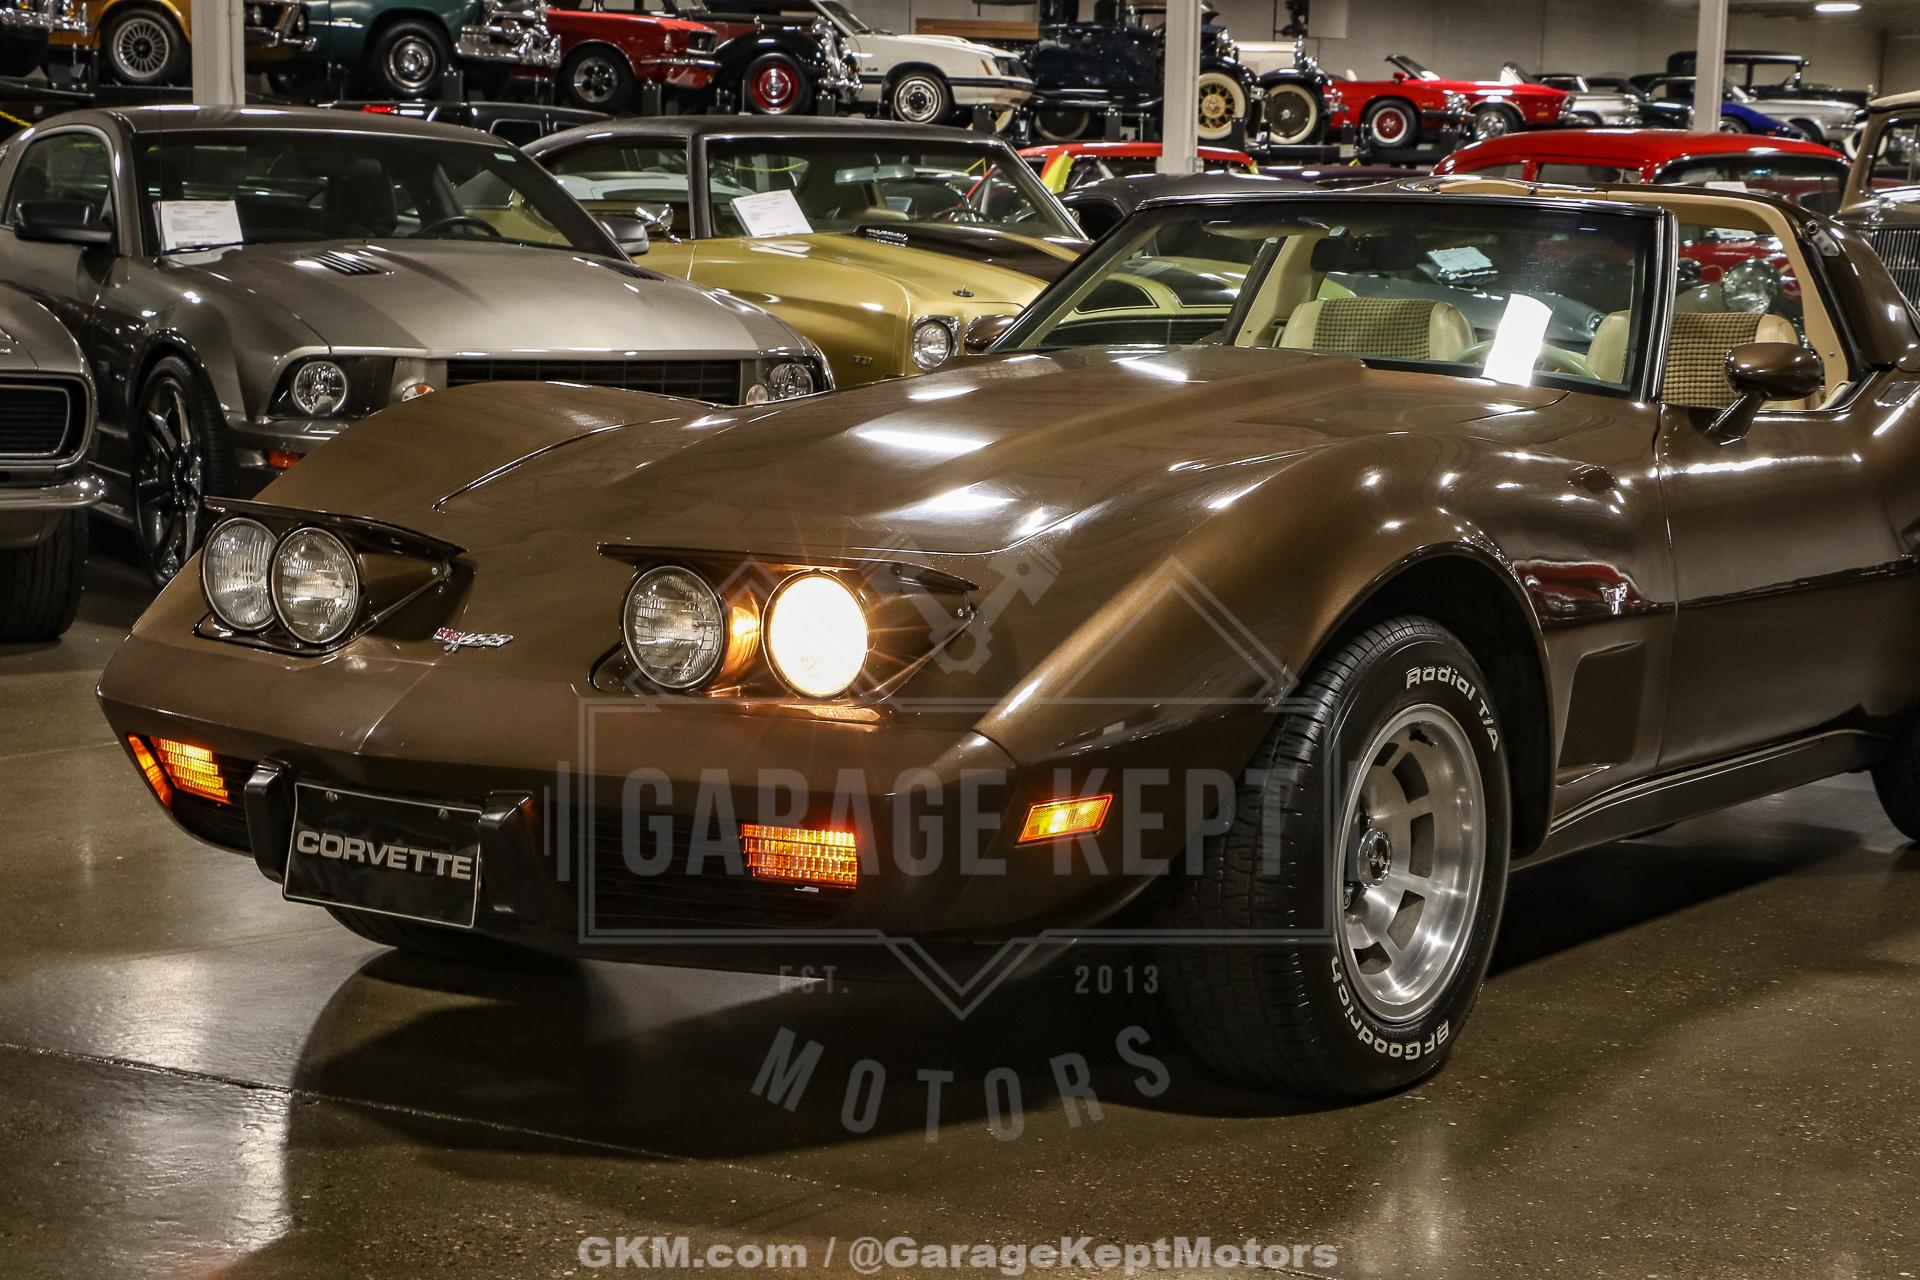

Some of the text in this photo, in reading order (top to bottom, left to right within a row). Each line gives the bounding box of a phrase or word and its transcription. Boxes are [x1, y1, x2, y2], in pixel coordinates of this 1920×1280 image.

[1406, 666, 1499, 752] Radial T/A
[297, 830, 472, 880] CORVETTE
[1331, 956, 1449, 1060] BFGoodrich
